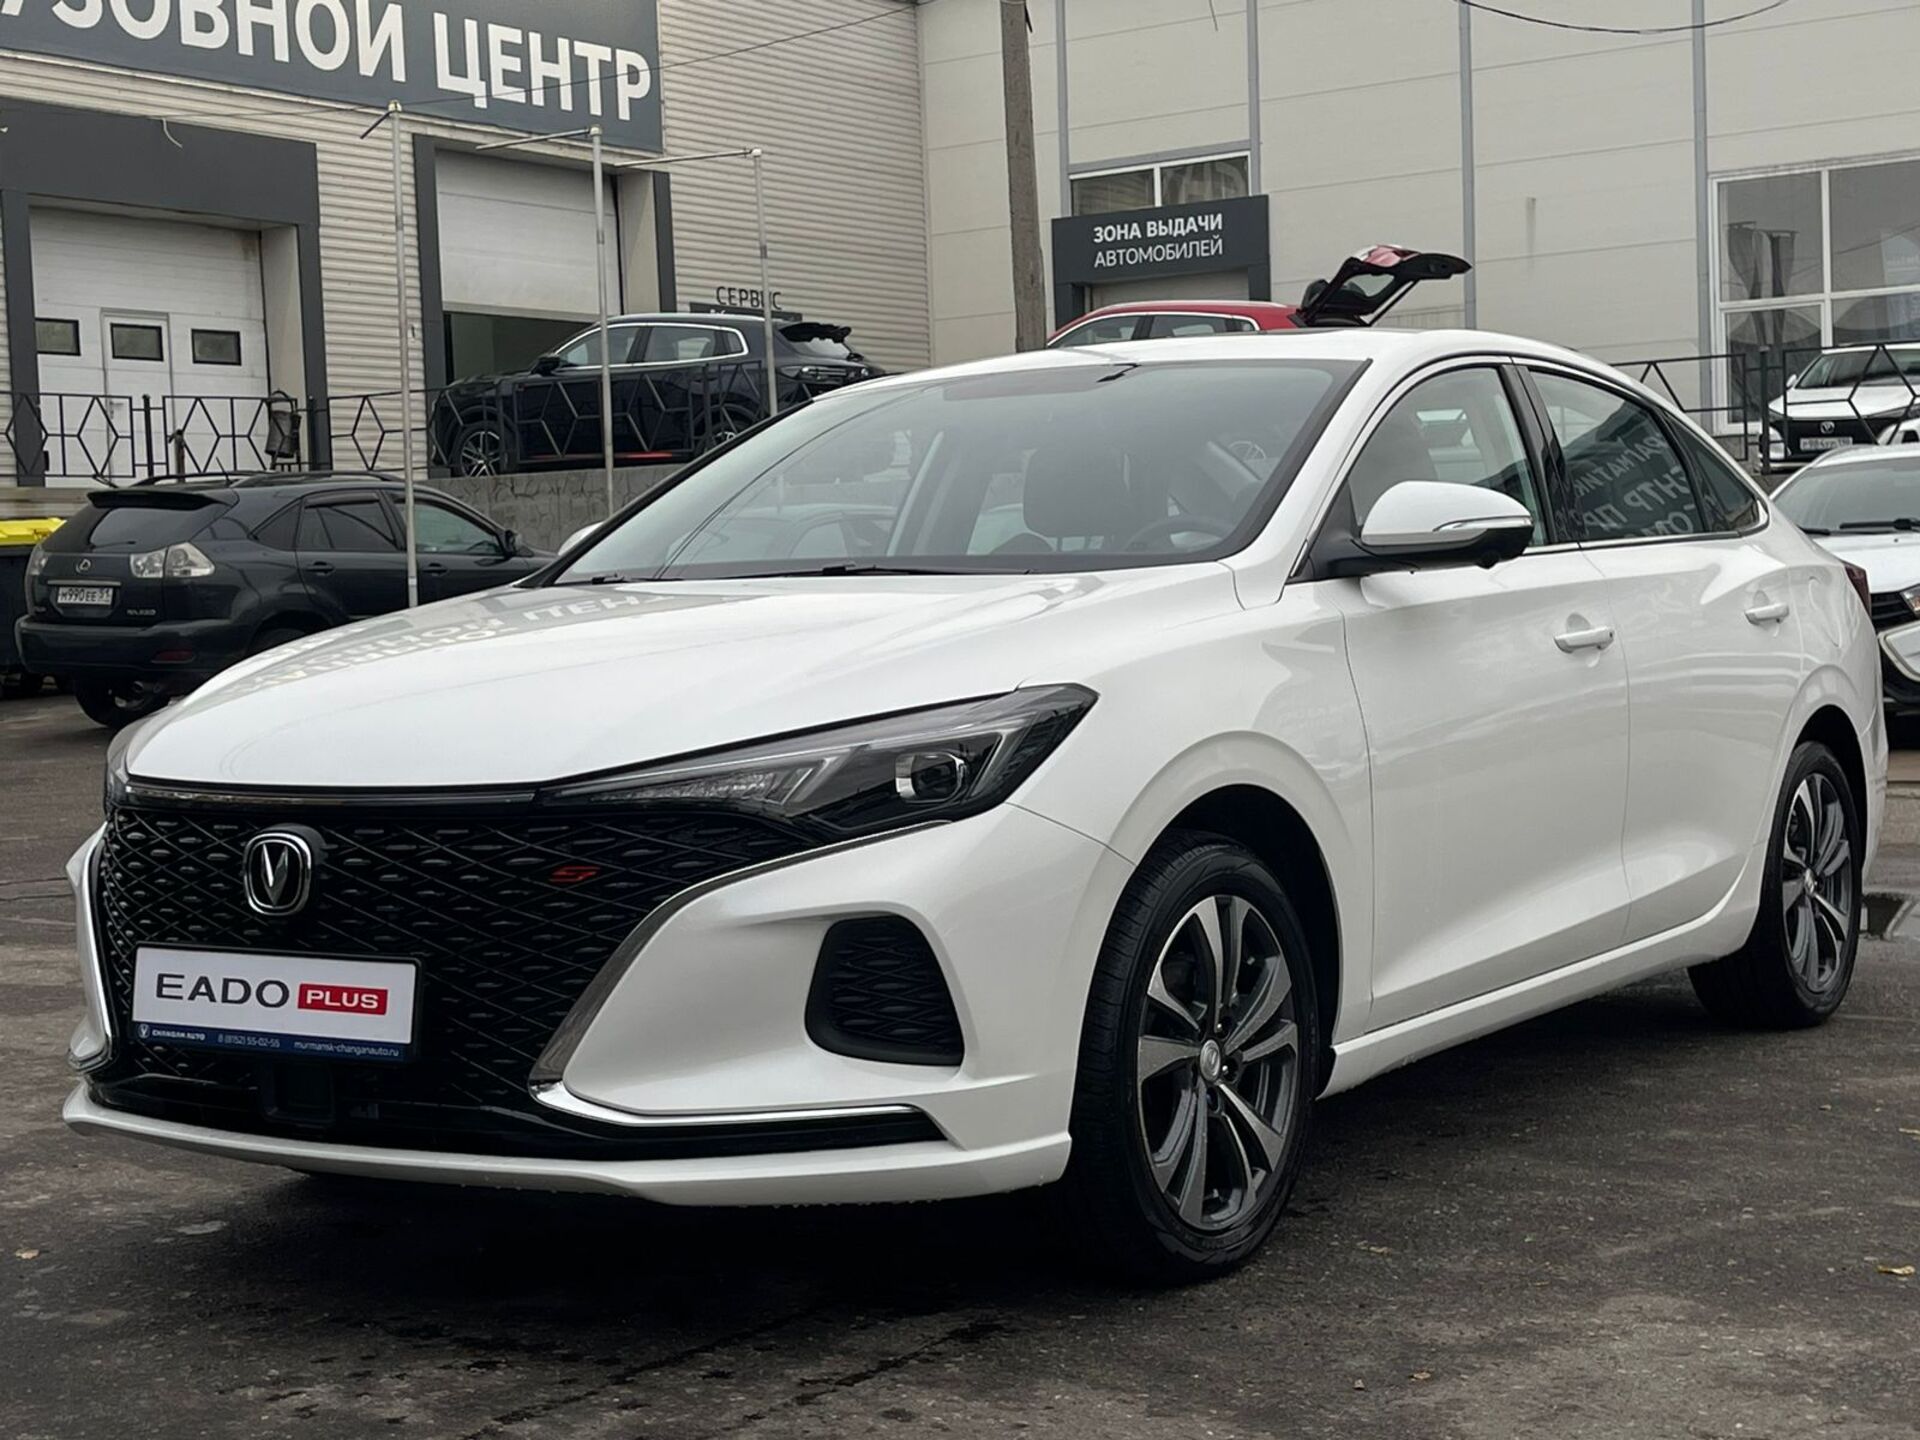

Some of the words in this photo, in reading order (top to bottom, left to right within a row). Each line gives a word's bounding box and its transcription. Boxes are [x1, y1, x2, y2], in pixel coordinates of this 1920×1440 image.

[433, 12, 651, 121] ЦЕНТР
[1093, 222, 1142, 243] ЗОНА
[1146, 213, 1223, 238] ВЫДАЧИ
[1094, 234, 1223, 268] АВТОМОБИЛЕЙ
[156, 973, 290, 1008] EADO
[306, 989, 379, 1009] PLUS
